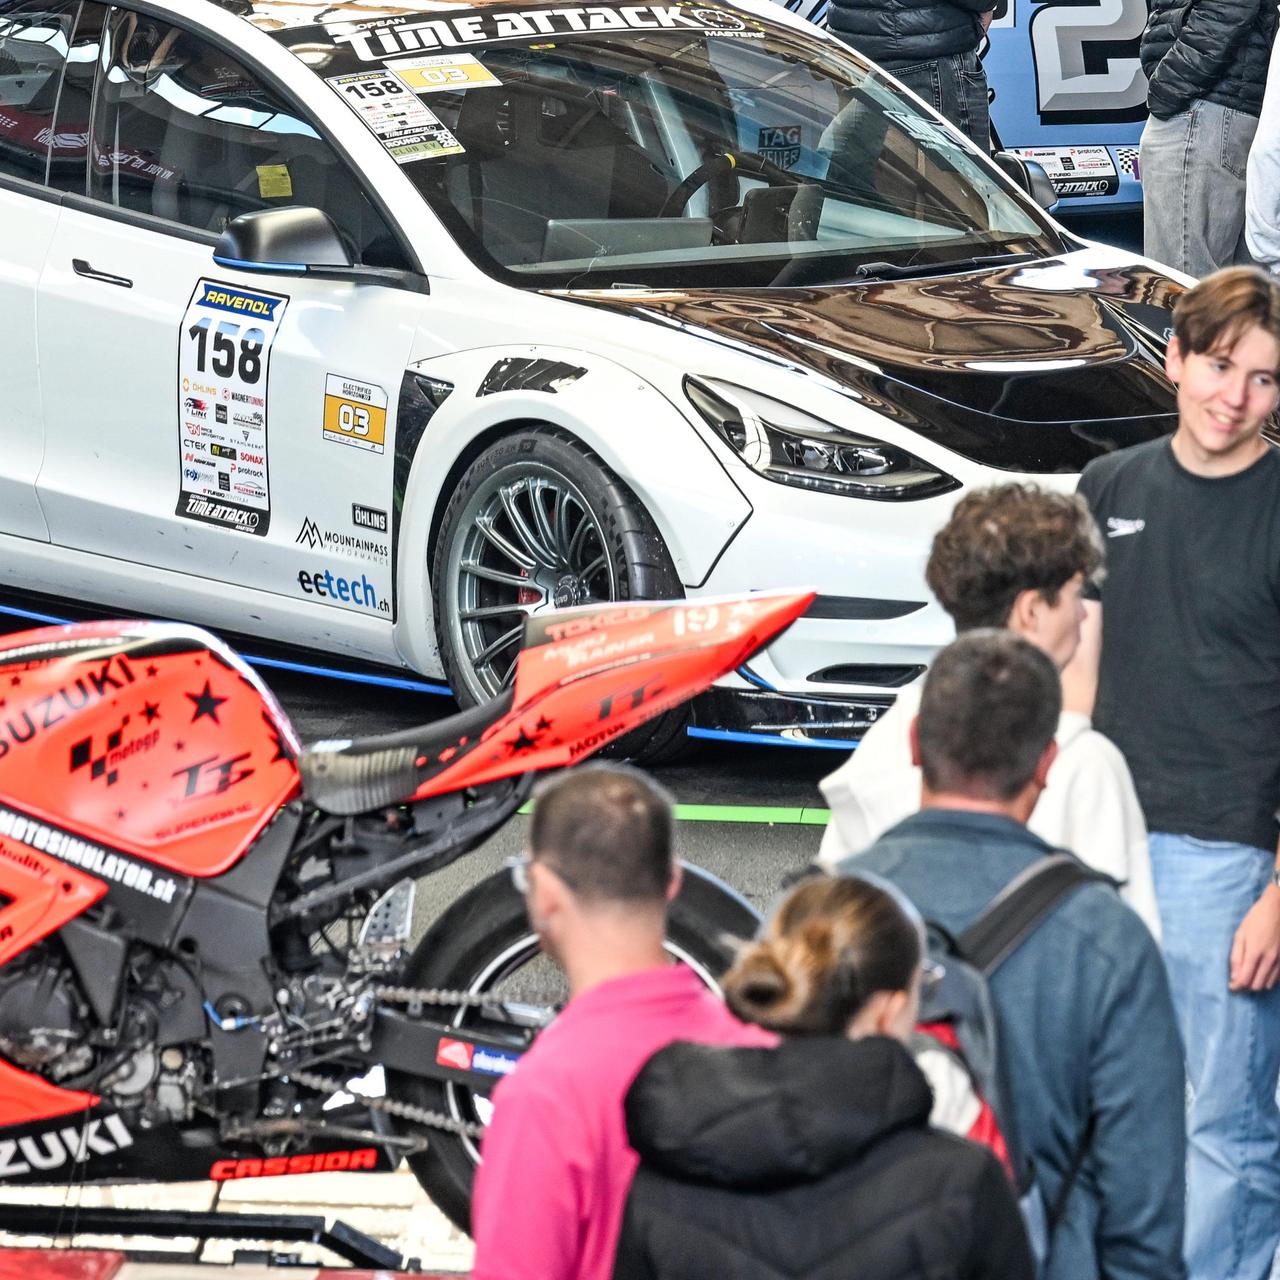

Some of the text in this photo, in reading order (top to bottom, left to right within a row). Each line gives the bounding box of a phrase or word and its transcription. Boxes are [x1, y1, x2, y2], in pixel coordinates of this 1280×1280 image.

[704, 30, 765, 39] MASTERS
[421, 67, 470, 84] 03
[345, 80, 404, 99] 158
[387, 137, 419, 149] ROUND
[761, 127, 800, 146] TAG
[392, 143, 436, 156] CLUB EV
[205, 291, 271, 315] RAVENOL
[188, 317, 266, 385] 158
[231, 391, 265, 407] WAGNERTUNING
[338, 402, 371, 437] 03
[183, 438, 207, 452] CTEK
[240, 452, 264, 465] SONAX
[354, 506, 386, 530] ÖHLINS
[324, 531, 388, 557] MOUNTAINPASS
[323, 543, 389, 567] PERFORMANCE
[109, 729, 161, 766] motogp
[209, 1148, 377, 1181] CASSIDA
